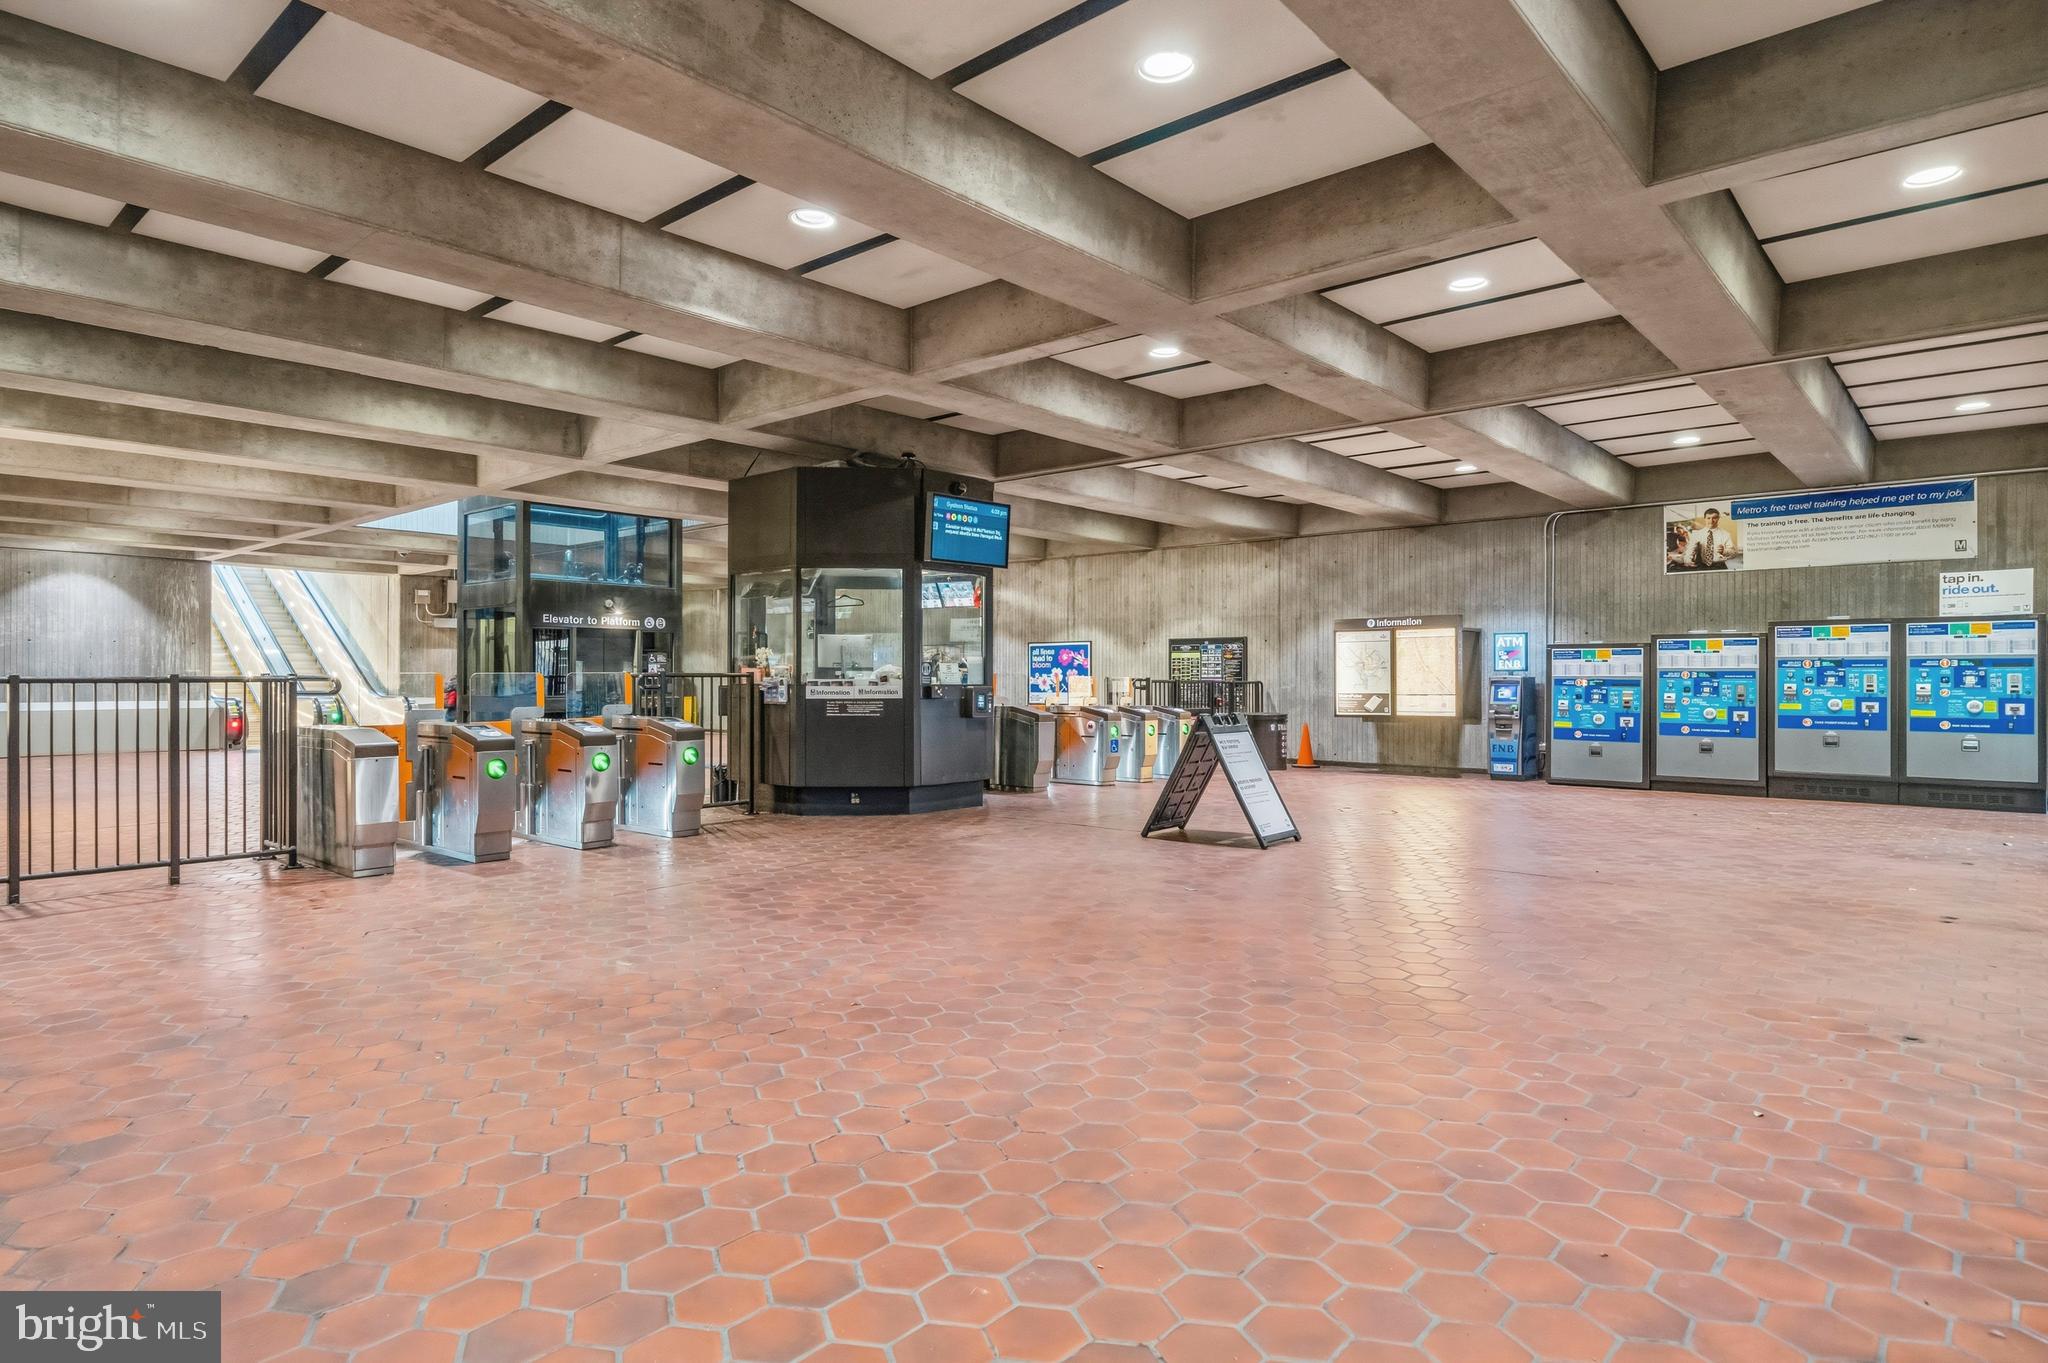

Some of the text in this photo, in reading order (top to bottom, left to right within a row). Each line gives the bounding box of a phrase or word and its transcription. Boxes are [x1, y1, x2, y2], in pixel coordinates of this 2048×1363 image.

[1736, 505, 1768, 515] Metro's
[1770, 504, 1787, 512] free
[1788, 502, 1812, 511] travel
[1813, 498, 1847, 508] training
[1848, 496, 1880, 506] helped
[1881, 495, 1897, 503] me
[1898, 493, 1914, 504] get
[1929, 491, 1945, 500] my
[1945, 488, 1964, 499] job.
[1825, 514, 1853, 522] benefits
[1943, 573, 1984, 585] tap in.
[1942, 584, 1999, 595] ride out.
[543, 614, 640, 627] Elevator to Platform
[1376, 618, 1422, 627] Information
[1497, 636, 1523, 648] ATM
[1032, 648, 1040, 656] all
[865, 688, 899, 696] Information
